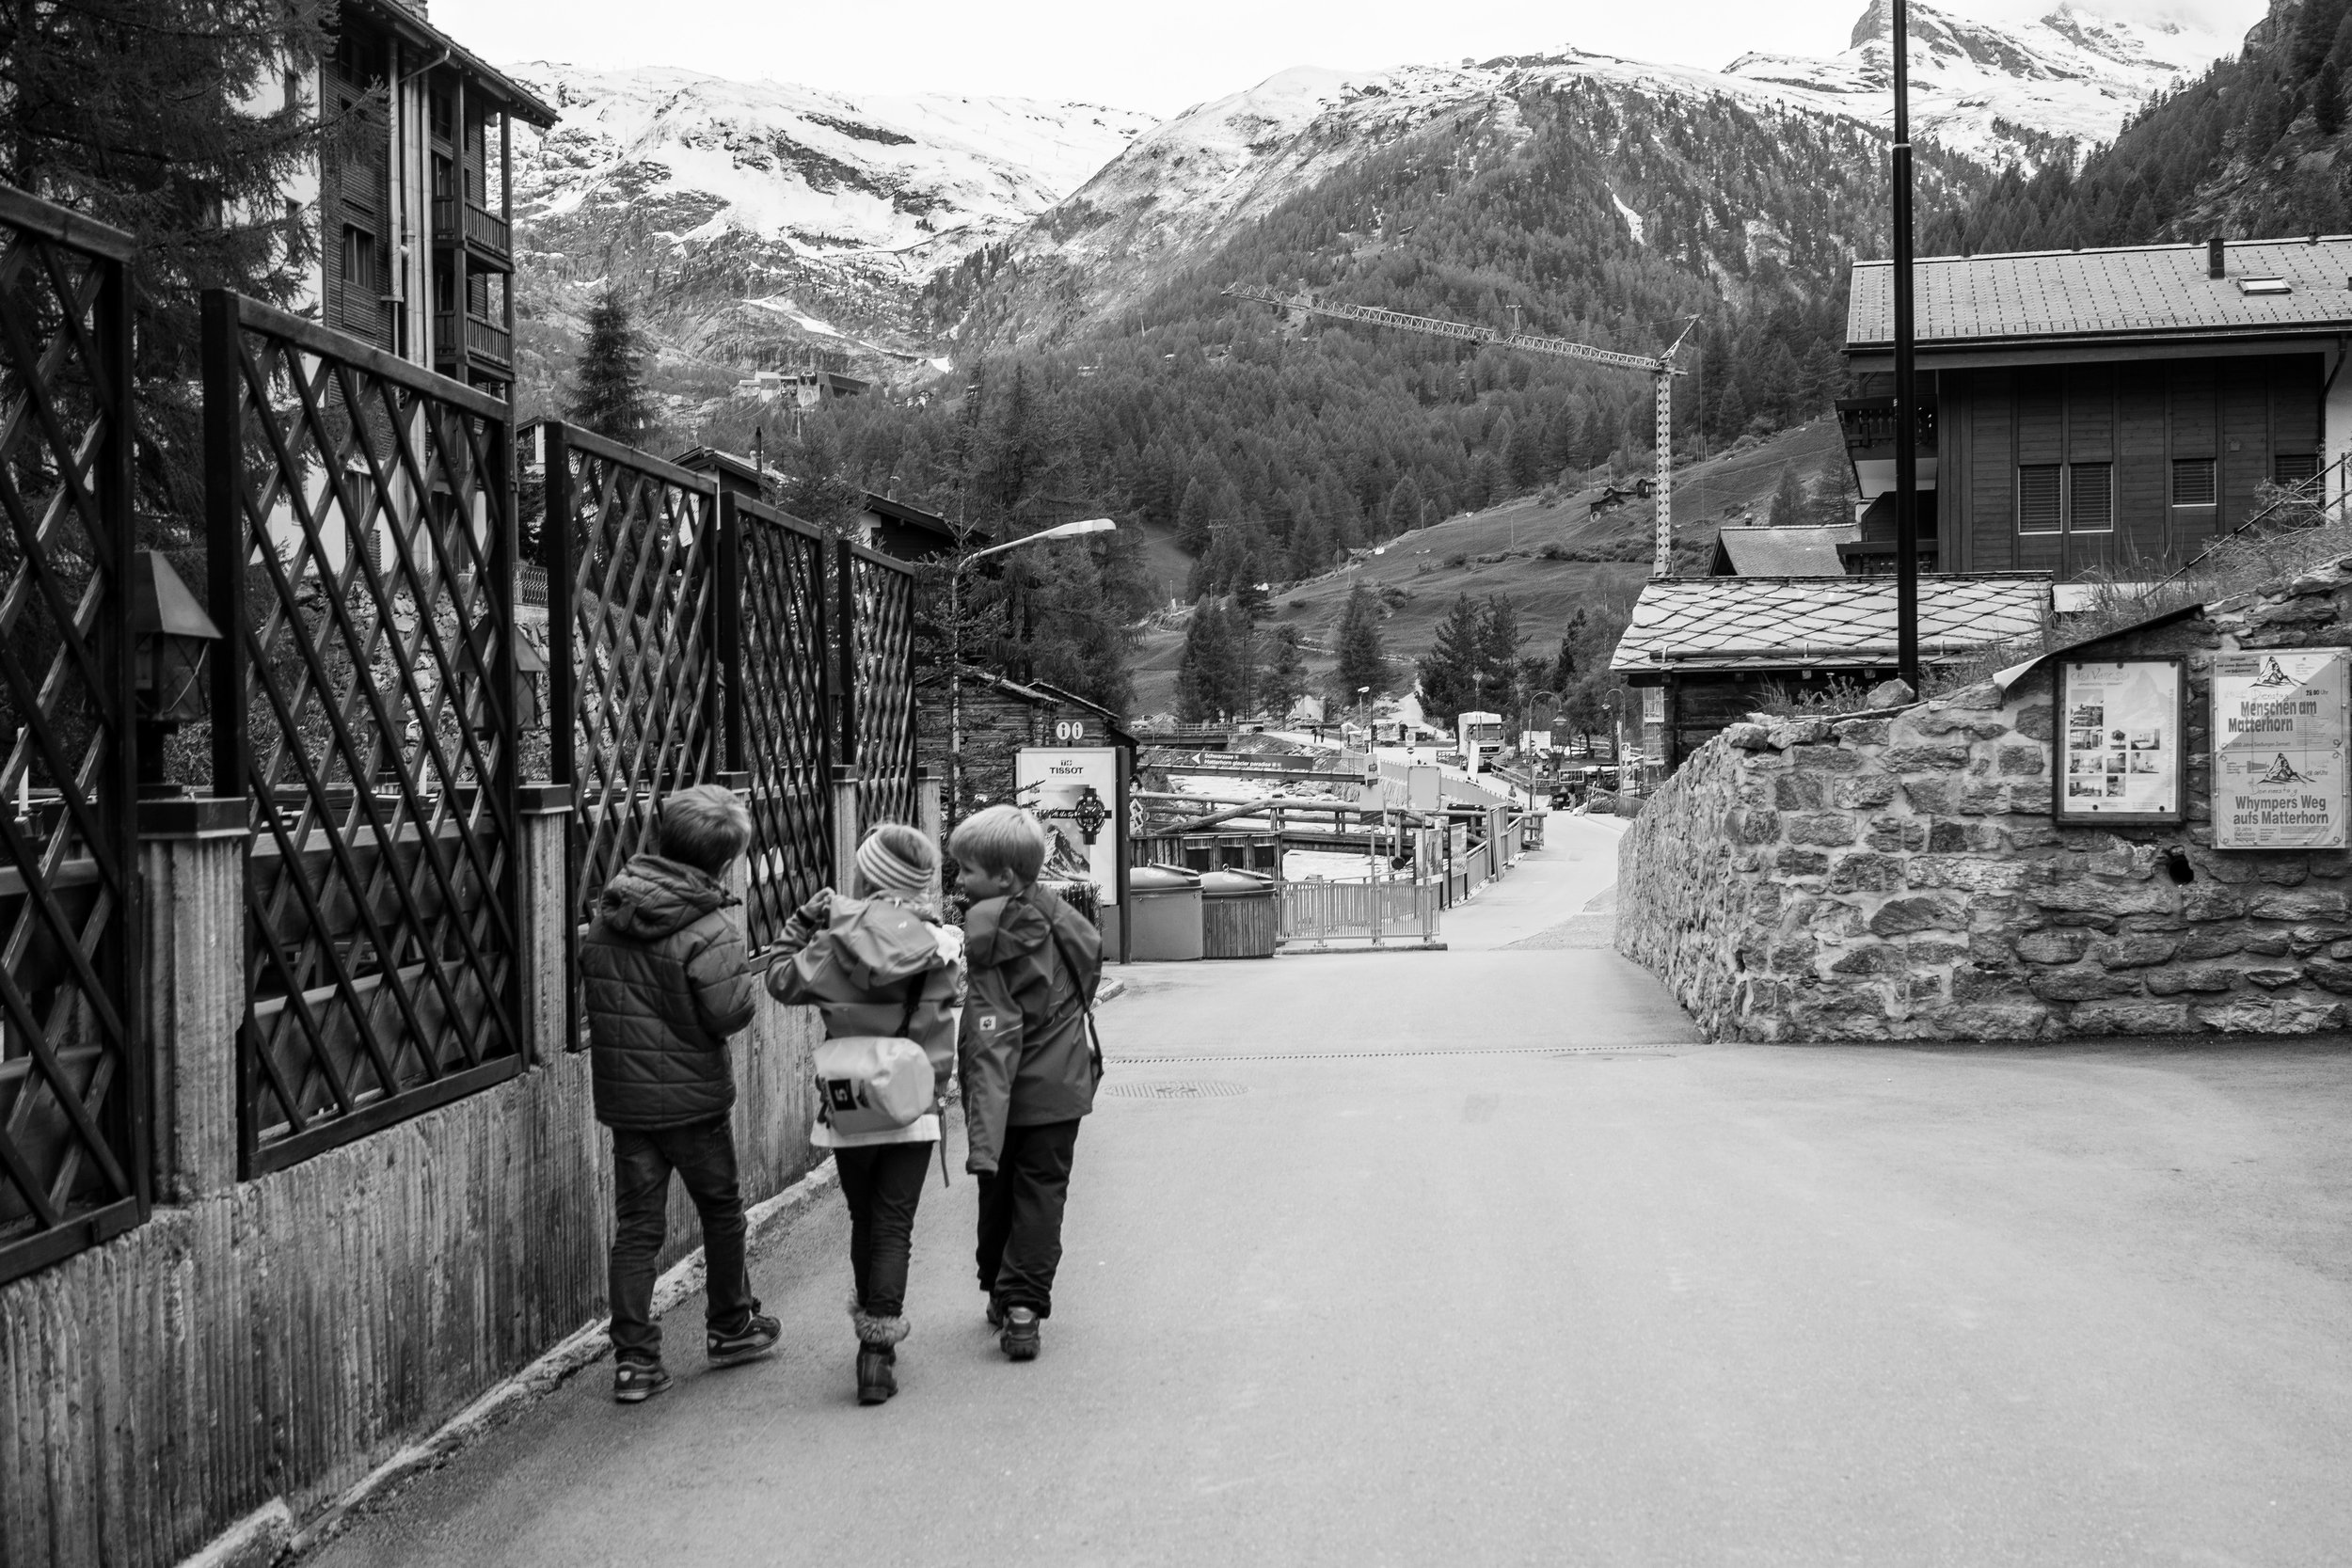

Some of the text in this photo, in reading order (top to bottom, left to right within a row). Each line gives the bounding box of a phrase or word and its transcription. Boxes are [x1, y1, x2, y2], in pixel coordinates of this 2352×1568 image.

[2240, 700, 2317, 716] Menschen am
[2228, 716, 2293, 732] Matterhorn
[1049, 767, 1084, 775] TISSOT
[2235, 795, 2327, 812] Whympers Weg
[2233, 810, 2328, 825] aufs Matterhorn
